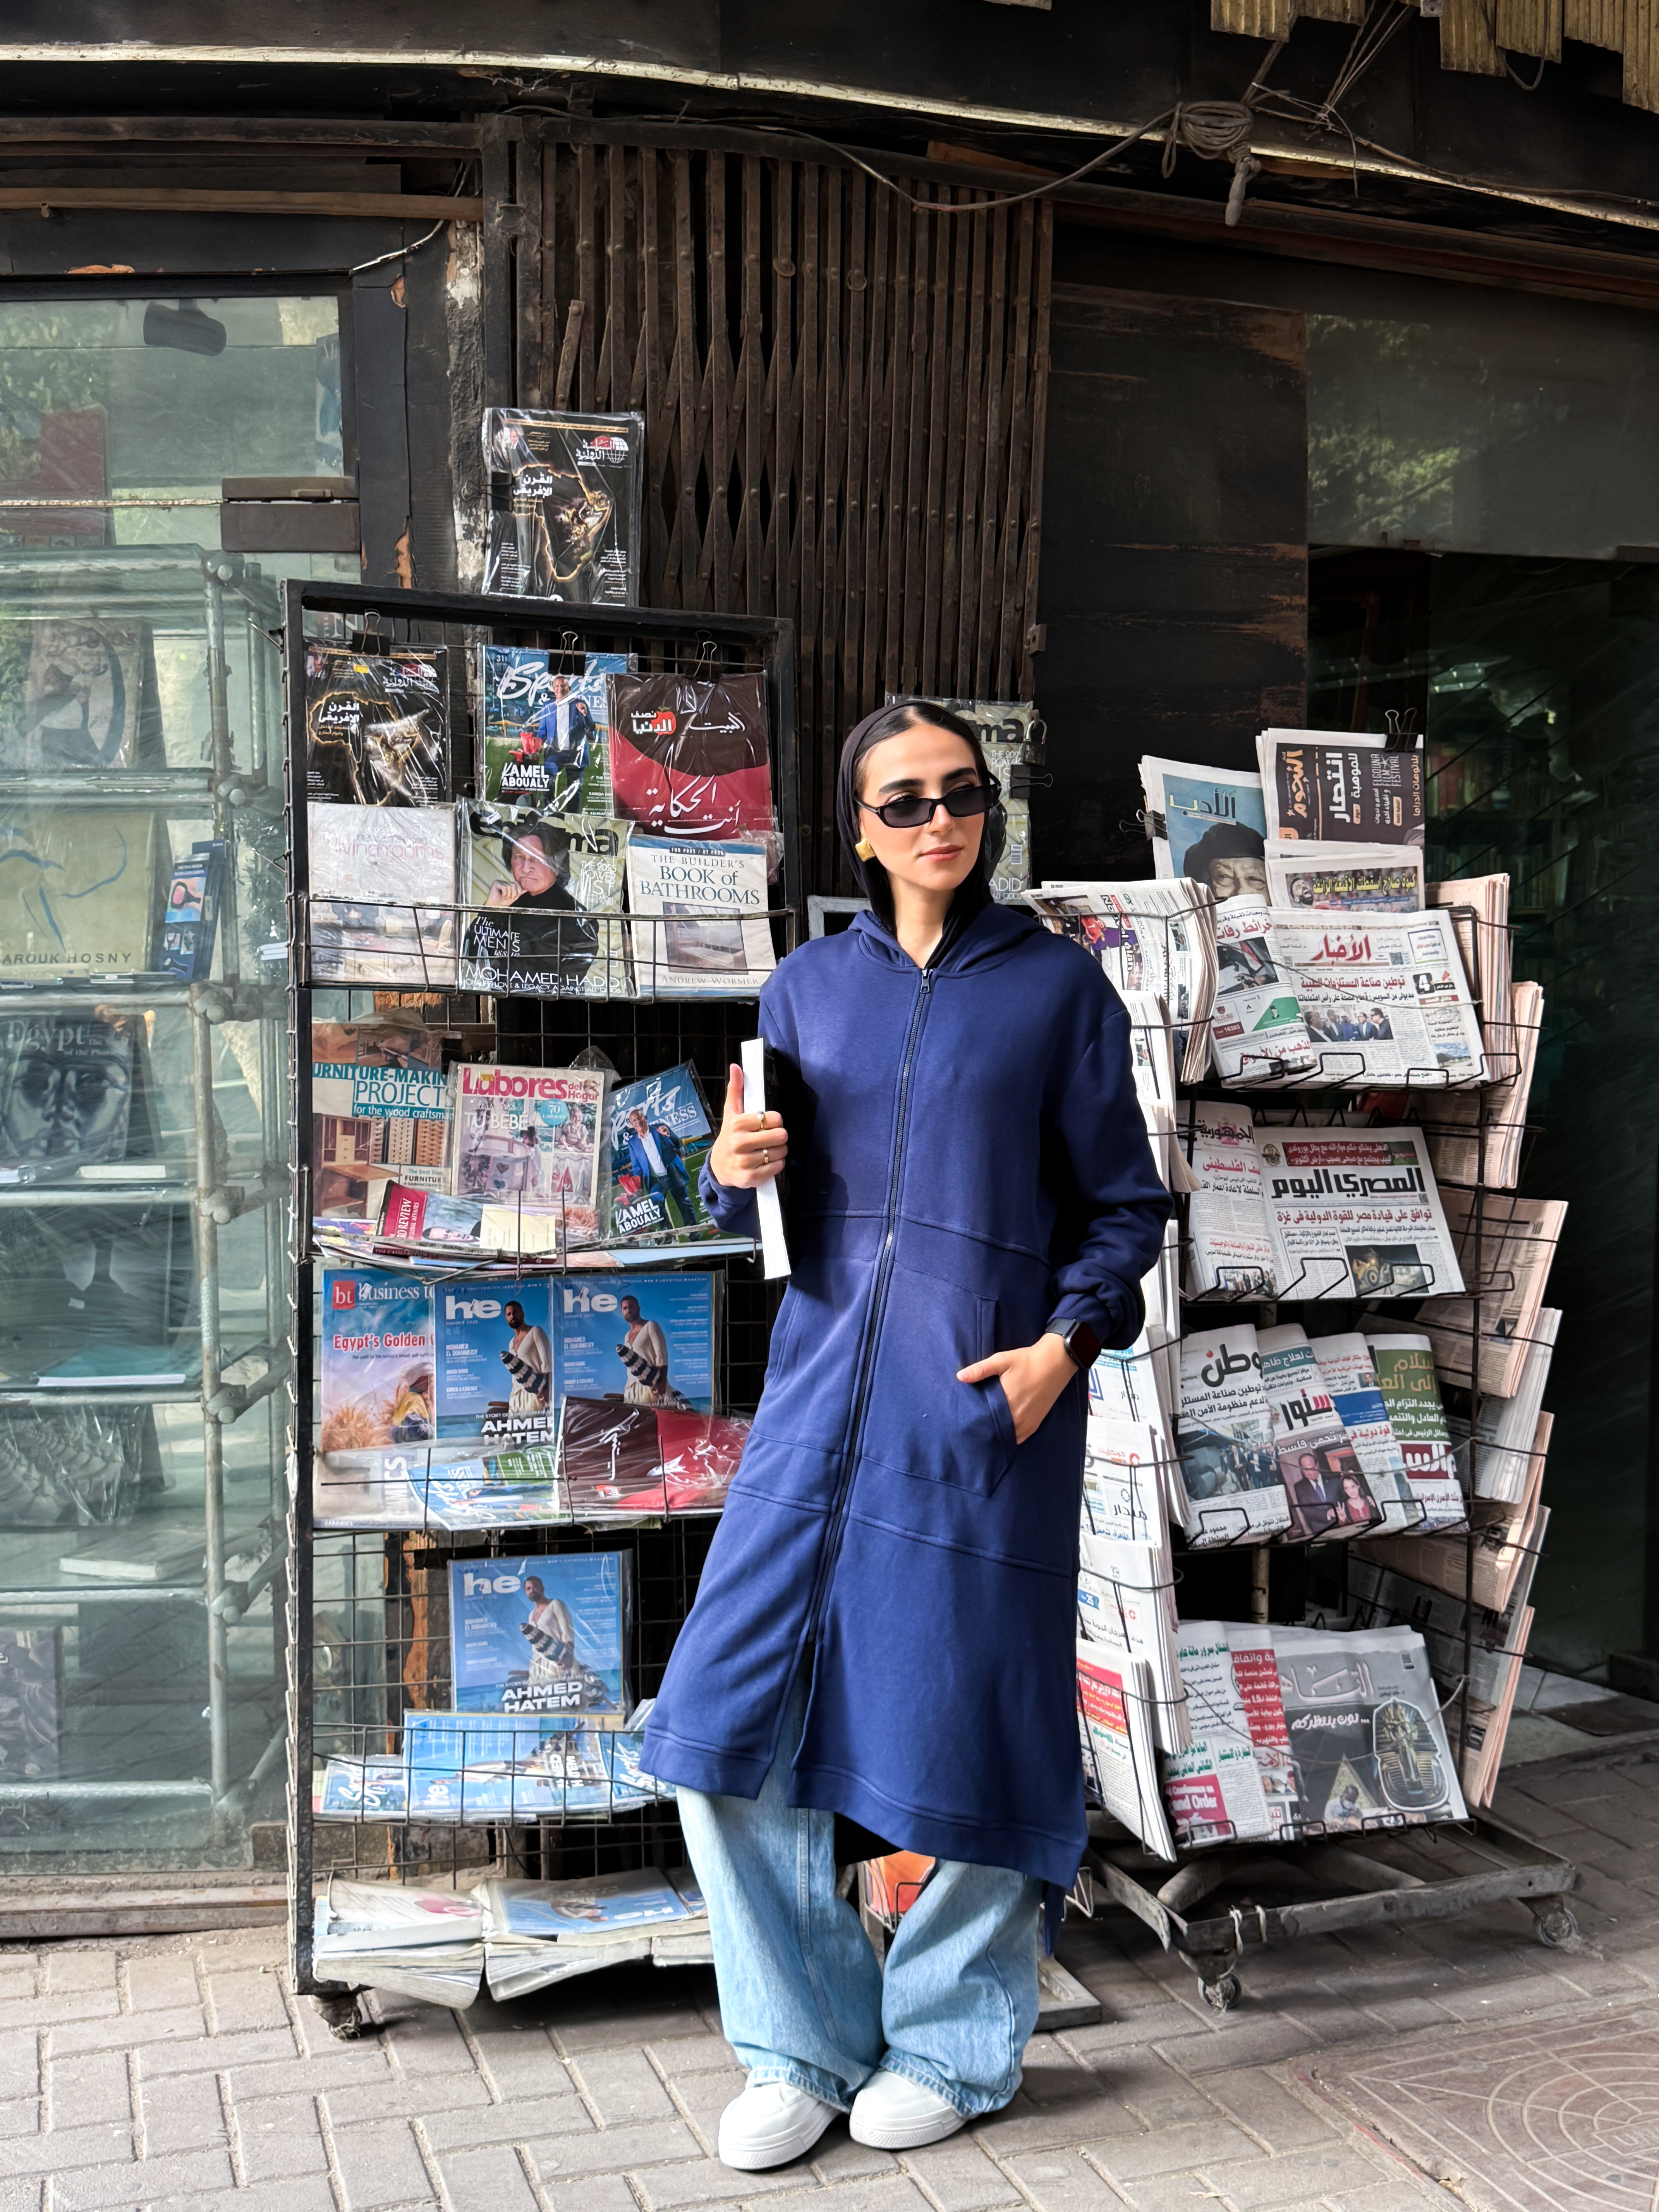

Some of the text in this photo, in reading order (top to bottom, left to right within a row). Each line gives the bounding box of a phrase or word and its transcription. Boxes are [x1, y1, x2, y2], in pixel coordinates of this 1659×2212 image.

[583, 437, 615, 450] السياسة
[576, 449, 605, 460] الدولية
[523, 474, 553, 485] القرن
[383, 676, 412, 687] الدولية
[329, 701, 359, 713] القرن
[539, 693, 550, 705] &
[631, 710, 657, 718] نصف
[689, 711, 745, 733] البيت
[632, 719, 672, 734] الدنيا
[501, 762, 549, 779] KAMEL
[1348, 753, 1362, 798] للموهبة
[1370, 754, 1382, 786] ELGOUNA
[1381, 769, 1392, 787] FILM
[1390, 756, 1401, 787] FESTIVAL
[501, 777, 549, 788] ABOUALY
[1326, 752, 1351, 823] انتصار
[646, 775, 717, 827] الحكاية
[1170, 788, 1236, 819] الأدب
[1412, 792, 1421, 816] الدراما
[664, 800, 742, 835] أنت
[581, 860, 595, 869] THE
[651, 854, 745, 868] THE BUILDER'S
[659, 866, 739, 886] BOOK of
[988, 877, 1023, 891] ADID
[640, 880, 760, 905] BATHROOMS
[1383, 879, 1400, 896] صلاح
[475, 915, 495, 927] The
[1242, 919, 1272, 934] خرائط
[474, 925, 520, 942] ULTIMATE
[474, 936, 520, 952] MENS
[1310, 933, 1371, 966] الأخبار
[2, 953, 132, 963] AROUK HOSNY
[465, 965, 562, 985] MOHAMED
[567, 974, 620, 988] HADD
[662, 975, 759, 985] ANDREW WORMER
[1361, 975, 1381, 988] صناعة
[1383, 975, 1405, 990] توطين
[1419, 974, 1430, 991] 4
[6, 1020, 86, 1051] Egypt
[1275, 1046, 1286, 1058] من
[313, 1063, 447, 1086] URNITURE-MAKIN
[462, 1067, 582, 1099] Labores del
[355, 1080, 456, 1107] PROJECTS
[568, 1090, 599, 1102] Hogar
[354, 1104, 365, 1114] for
[368, 1105, 382, 1115] the
[385, 1108, 410, 1118] wood
[549, 1105, 560, 1115] 70
[464, 1112, 528, 1130] TU BEBÉ
[622, 1132, 633, 1146] &
[1198, 1120, 1254, 1144] الجمهورية
[1203, 1157, 1246, 1172] الفلسطينى
[1271, 1168, 1426, 1199] المصري اليوم
[398, 1198, 412, 1229] REVIEW
[615, 1198, 659, 1226] KAMEL
[1277, 1209, 1432, 1225] توافق على قيادة مصر للقوة الدولية فى غزة
[619, 1208, 661, 1234] ABOUALY
[335, 1285, 353, 1304] bt
[358, 1282, 419, 1301] business
[564, 1288, 618, 1313] he
[446, 1295, 501, 1320] he
[333, 1332, 426, 1352] Egypt's Golden
[1282, 1351, 1304, 1367] لعلاج
[1212, 1384, 1261, 1399] توطين صناعة
[1197, 1400, 1247, 1417] منظومة الأمن
[1396, 1399, 1417, 1410] التزام
[1417, 1414, 1438, 1424] العادل
[1278, 1440, 1308, 1455] فلسط
[464, 1573, 521, 1596] he
[501, 1681, 583, 1702] AHMED
[504, 1694, 580, 1713] HATEM
[1173, 1793, 1218, 1810] and Order
